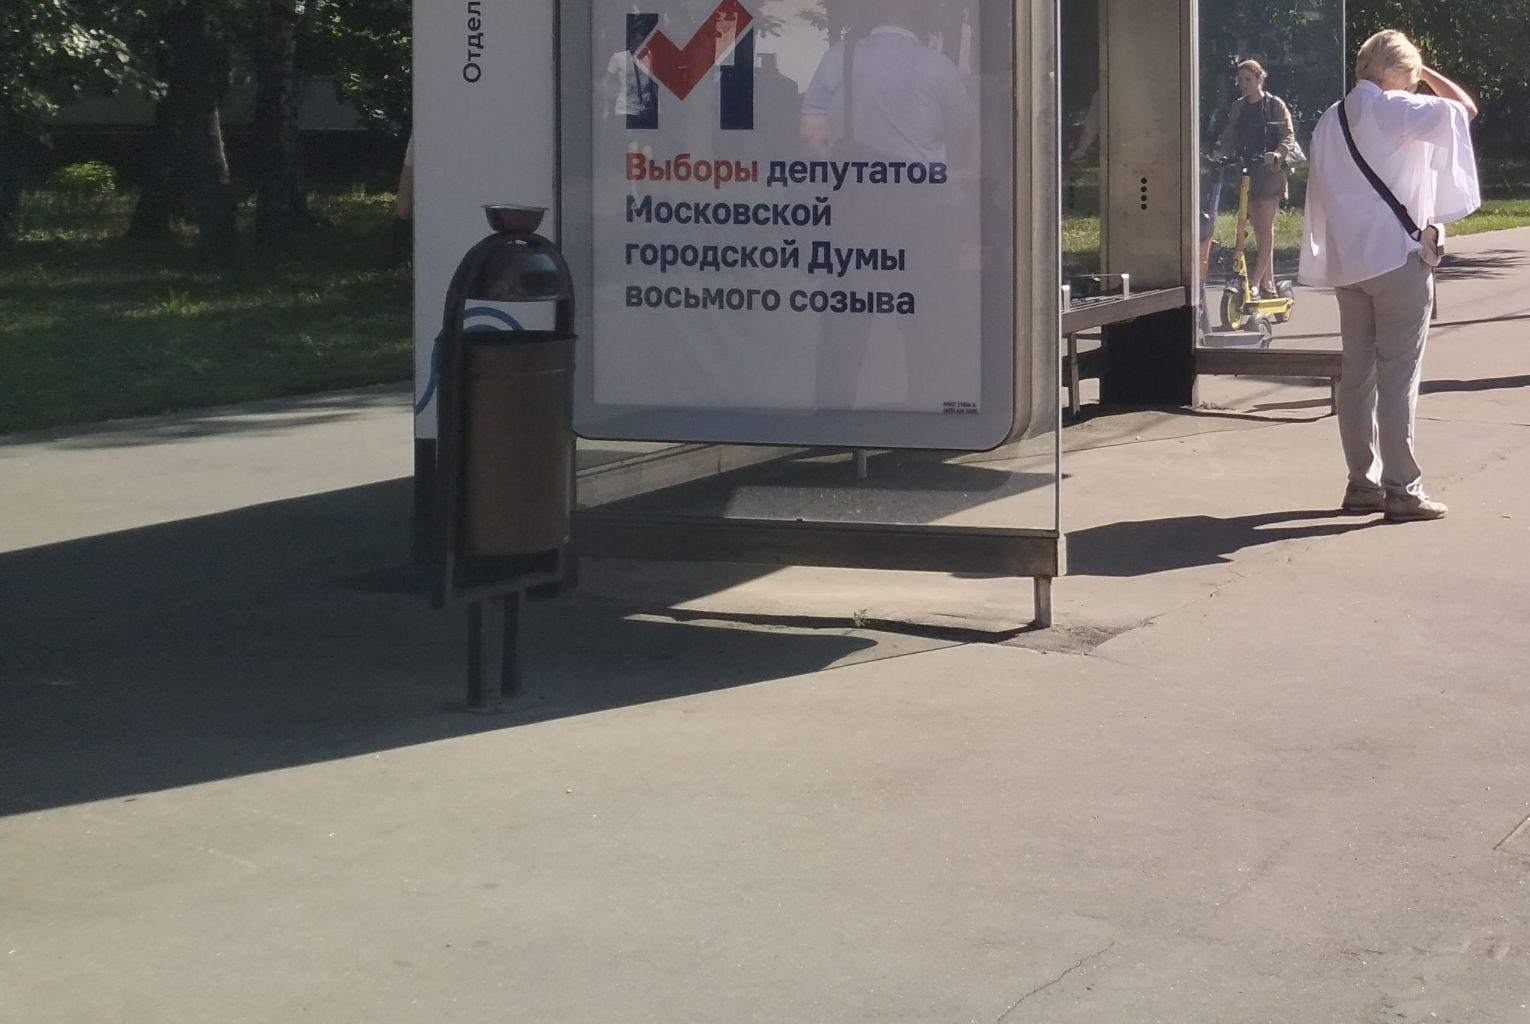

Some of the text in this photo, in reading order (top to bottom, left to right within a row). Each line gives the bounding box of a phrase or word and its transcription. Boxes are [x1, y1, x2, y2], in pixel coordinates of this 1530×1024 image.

[625, 152, 948, 191] Выборы депутатов
[625, 195, 832, 226] Московской
[625, 239, 906, 277] городской Думы
[625, 285, 916, 315] восьмого созыва
